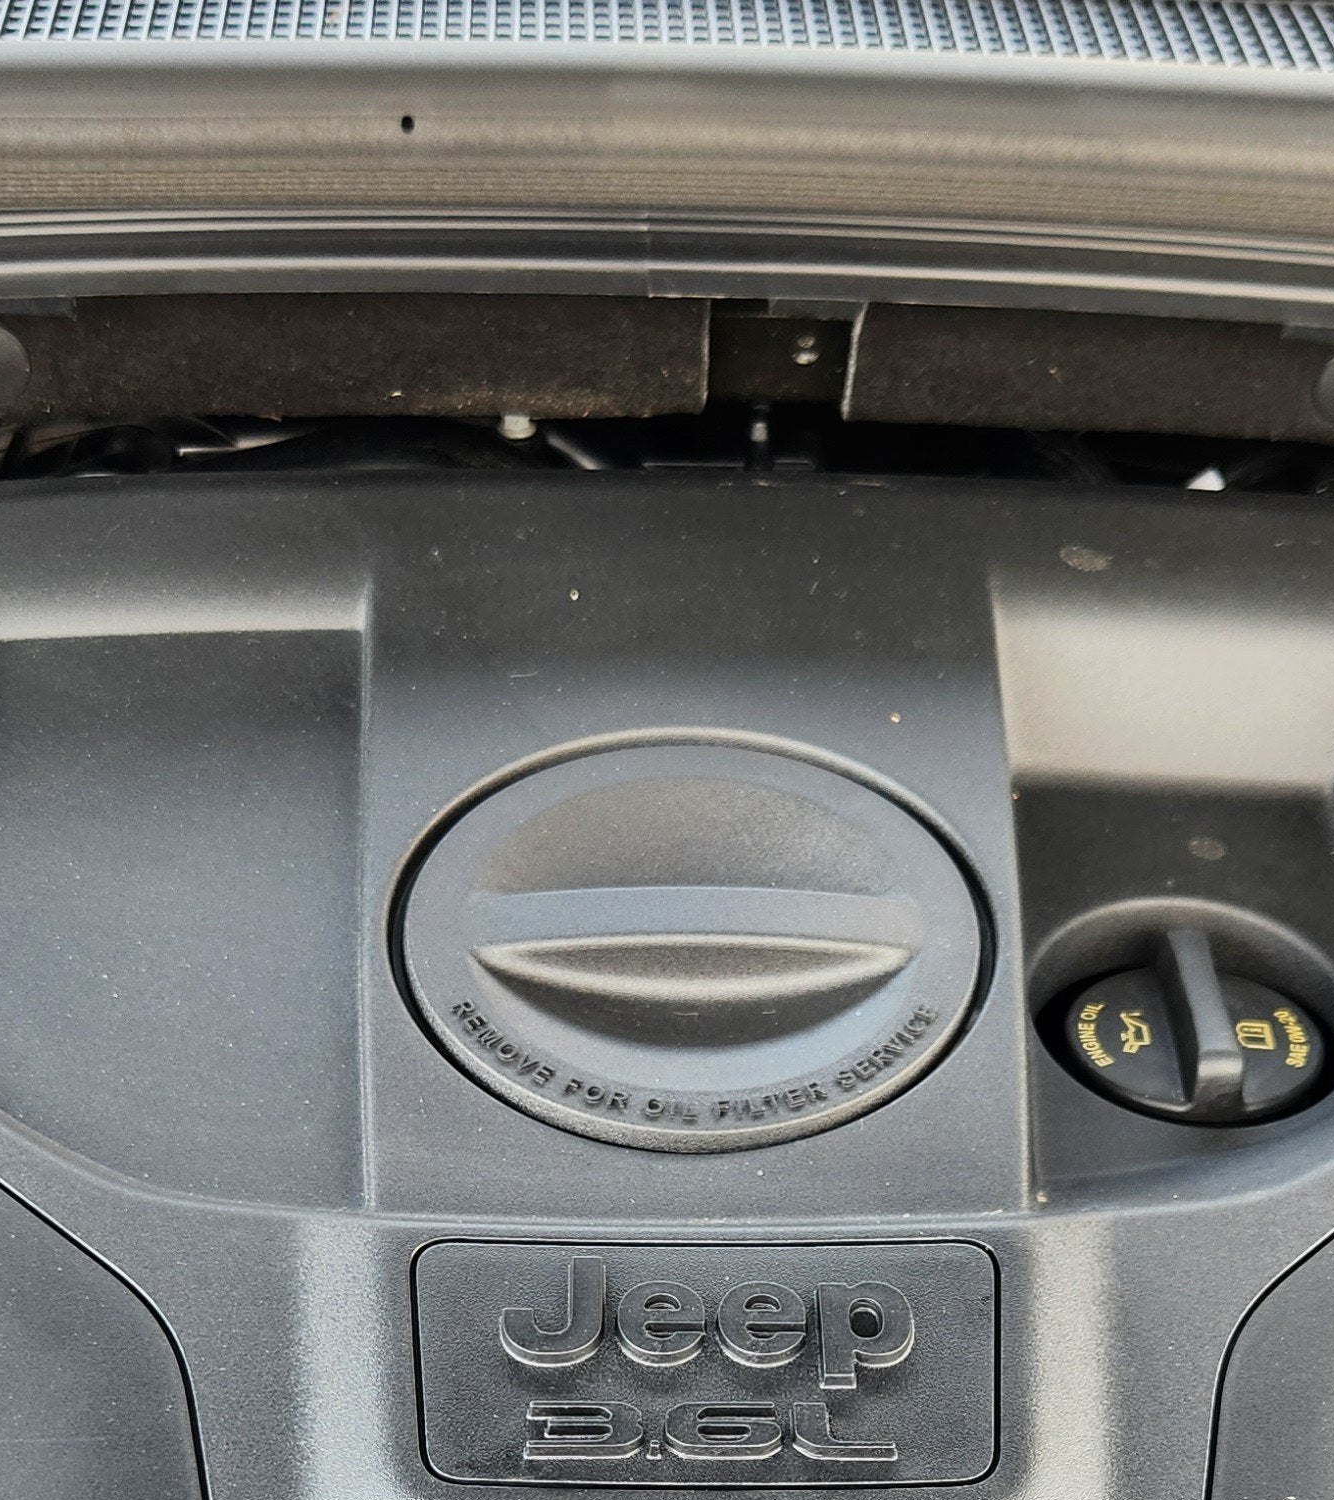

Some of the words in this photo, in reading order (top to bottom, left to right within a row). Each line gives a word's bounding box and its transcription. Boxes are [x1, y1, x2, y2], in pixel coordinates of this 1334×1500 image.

[1080, 1003, 1105, 1020] OIL
[451, 999, 556, 1086] REMOVE
[564, 1078, 629, 1112] FOR
[643, 1098, 698, 1122] OIL
[717, 1082, 828, 1118] FILTER
[836, 1003, 939, 1089] SERVICE
[1078, 1023, 1115, 1067] ENGINE
[1285, 1043, 1310, 1068] SAE
[500, 1256, 915, 1390] Jeep
[523, 1401, 899, 1460] 3.6L
